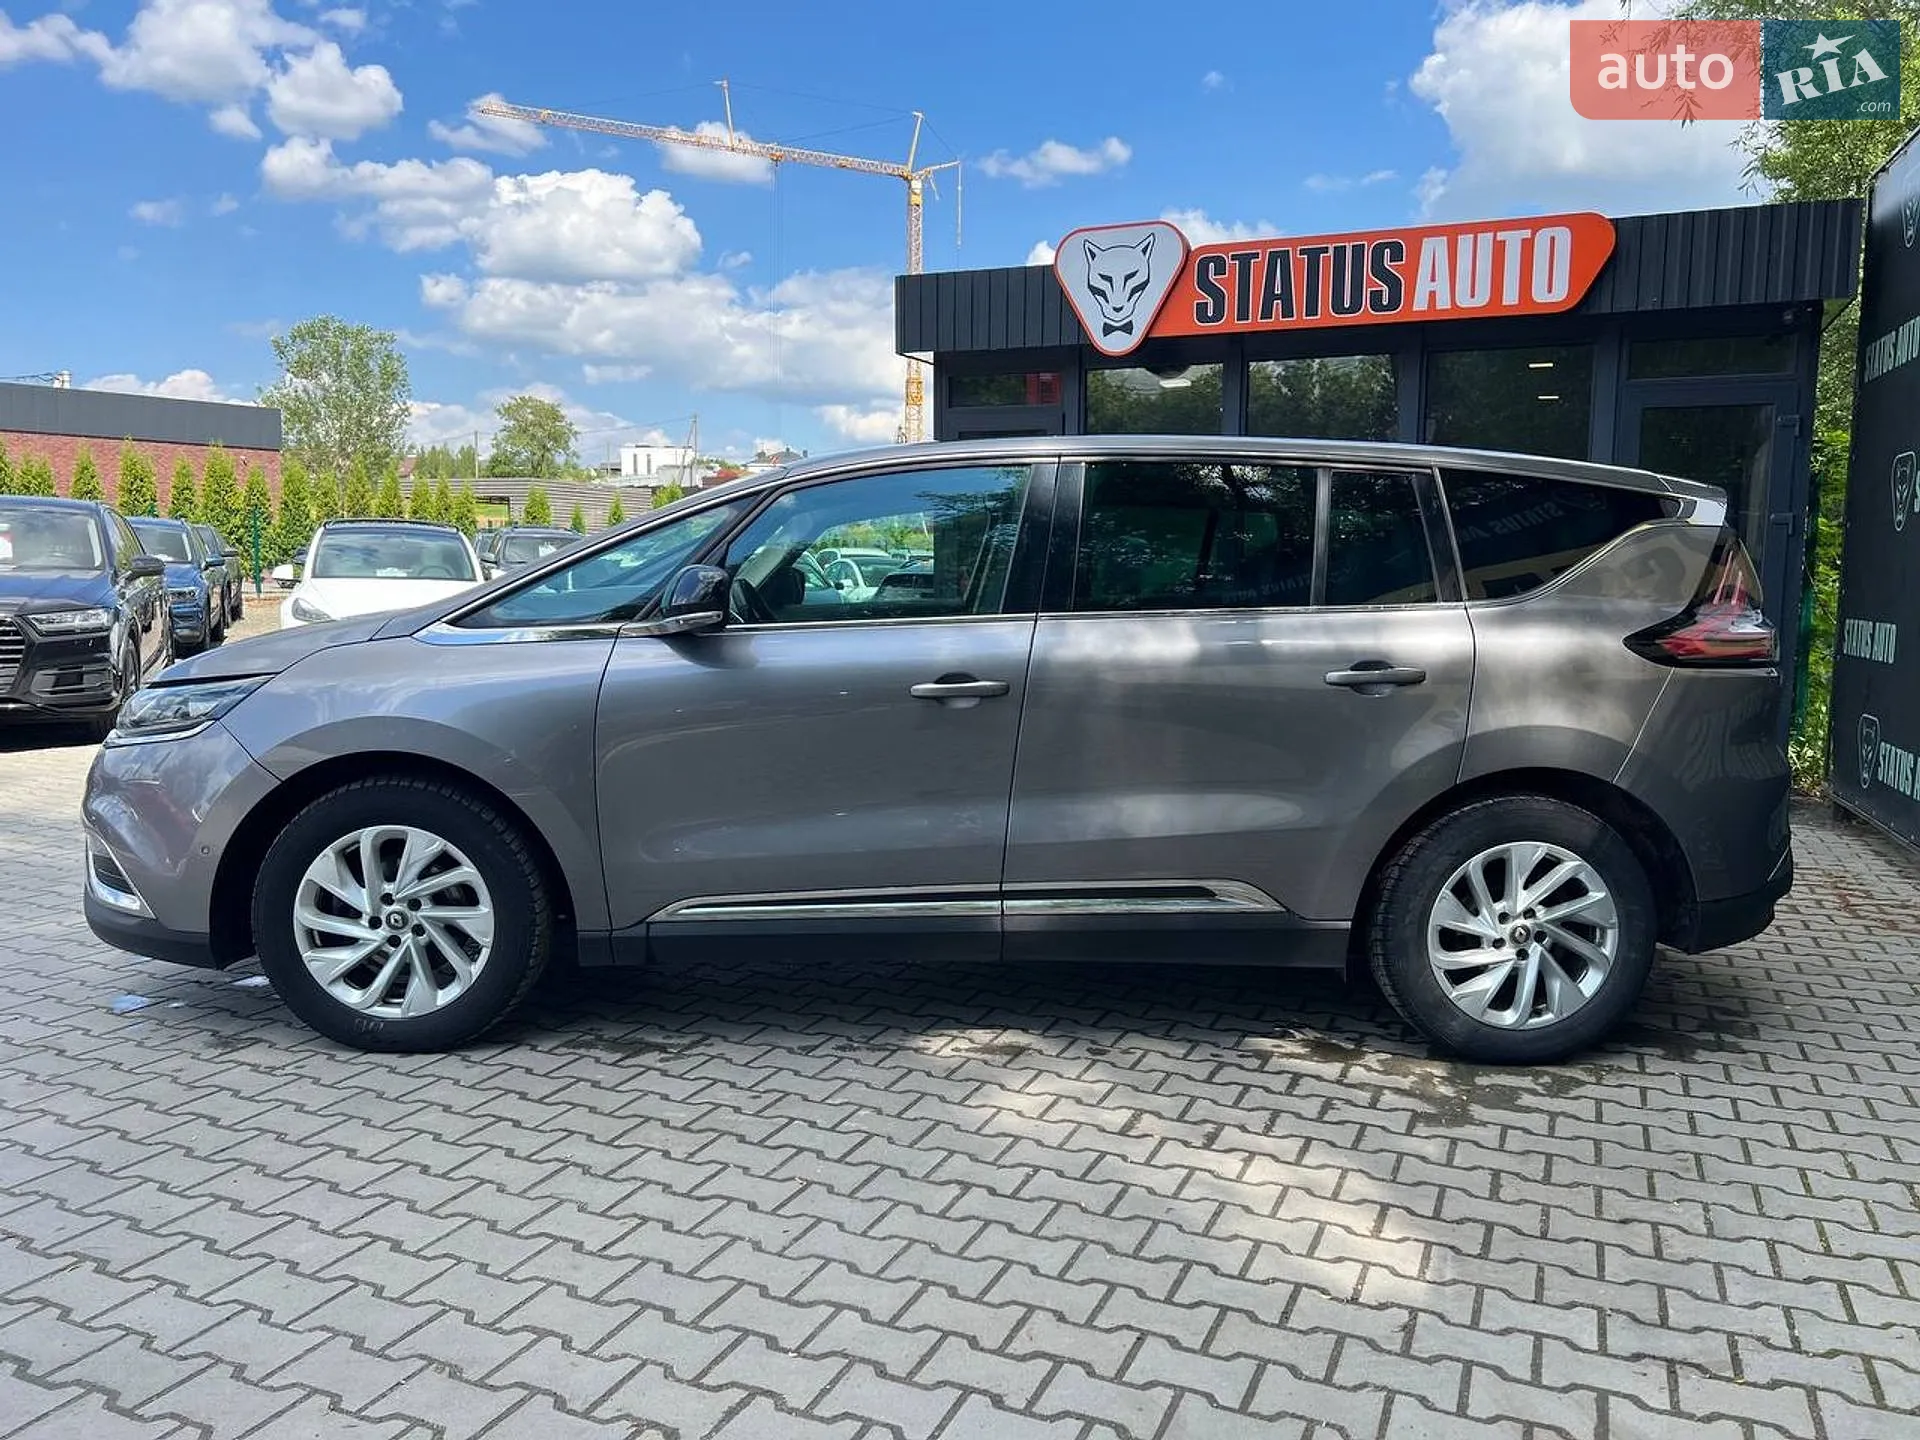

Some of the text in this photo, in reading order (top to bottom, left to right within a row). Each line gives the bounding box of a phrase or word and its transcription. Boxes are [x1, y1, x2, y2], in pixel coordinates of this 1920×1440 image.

[1194, 226, 1572, 326] STATUS AUTO
[1843, 618, 1873, 659] STATUS
[1878, 741, 1914, 796] STATUS
